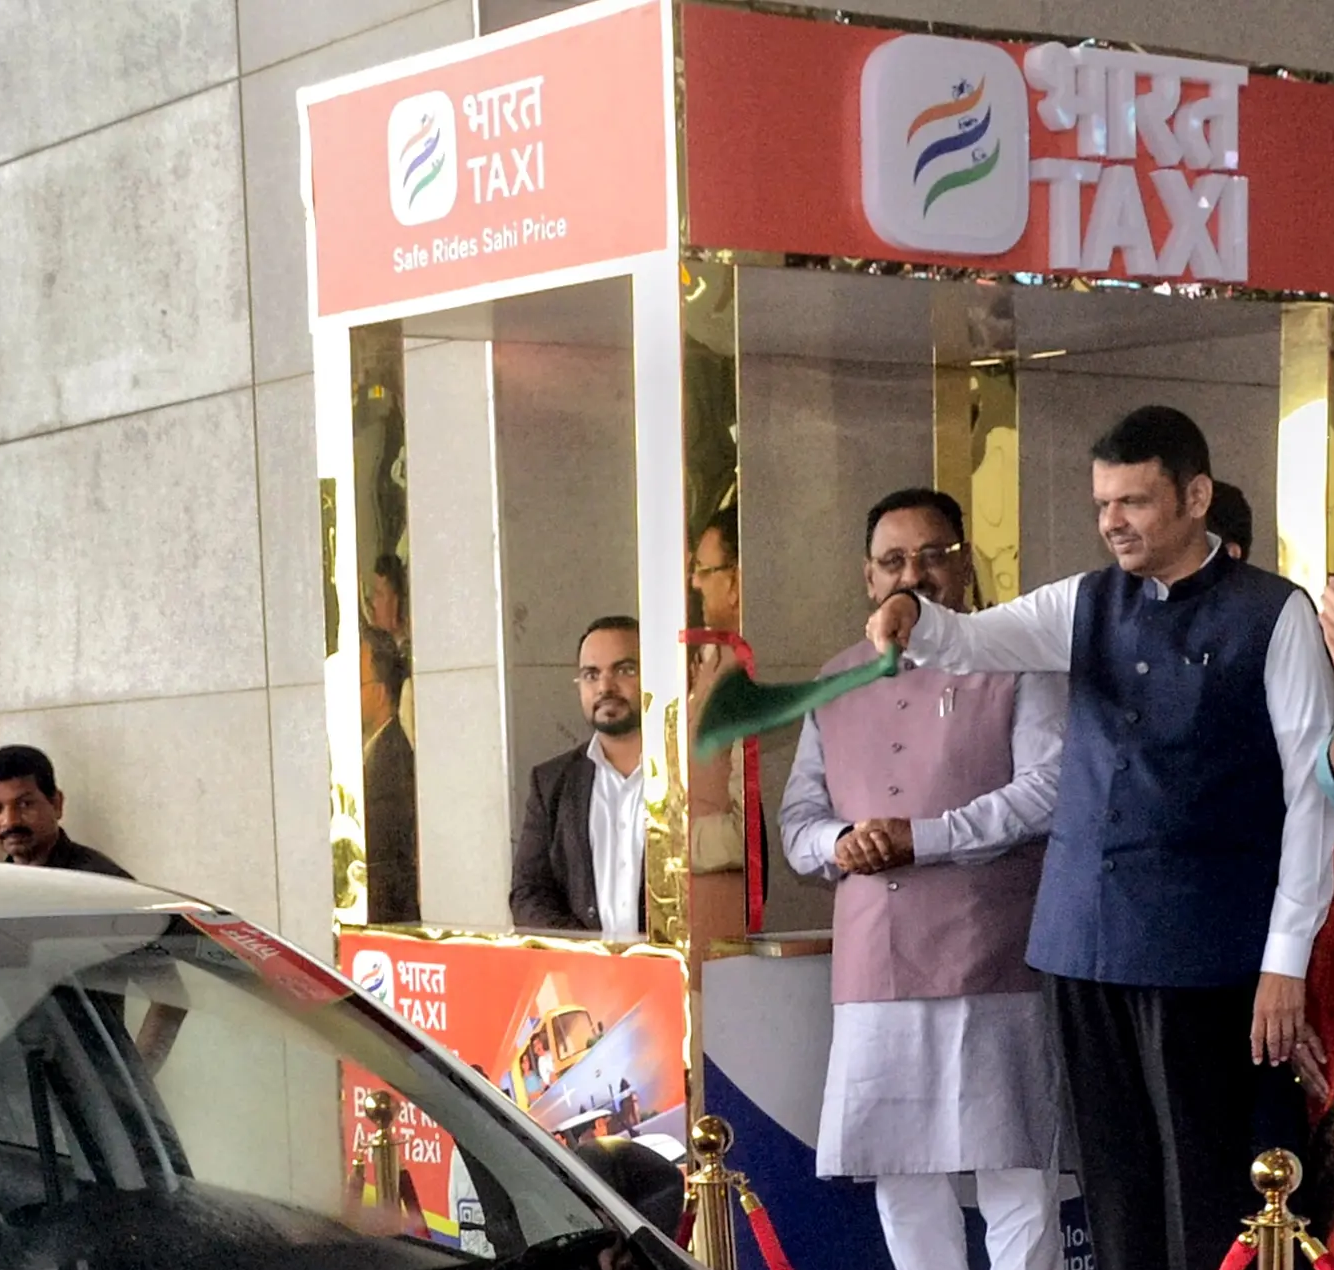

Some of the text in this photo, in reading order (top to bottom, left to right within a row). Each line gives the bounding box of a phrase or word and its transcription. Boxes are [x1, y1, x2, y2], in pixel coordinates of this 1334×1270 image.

[463, 75, 544, 140] भारत
[1023, 42, 1248, 170] भारत
[466, 141, 545, 204] TAXI
[393, 214, 567, 273] Safe Rides Sahi Price
[1029, 158, 1248, 282] TAXI
[397, 960, 446, 995] भारत
[399, 998, 447, 1031] TAXI
[400, 1127, 441, 1164] Taxi
